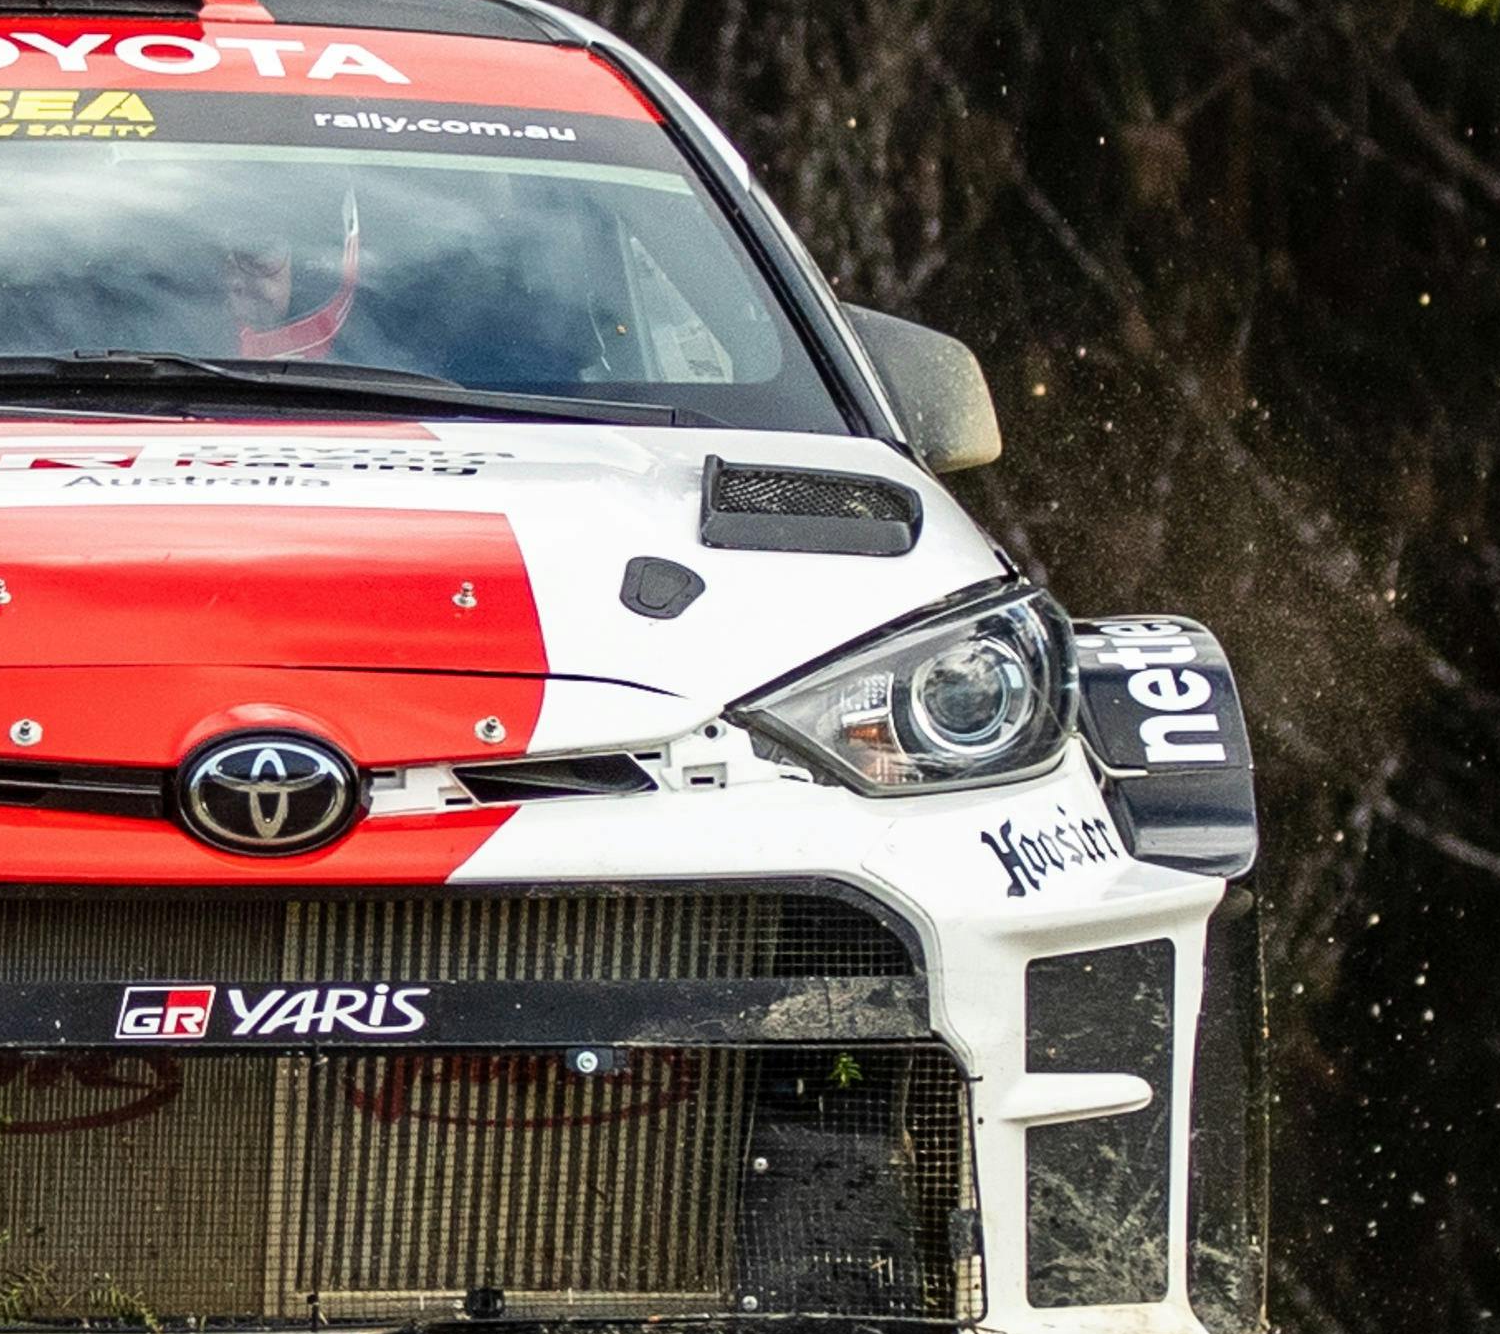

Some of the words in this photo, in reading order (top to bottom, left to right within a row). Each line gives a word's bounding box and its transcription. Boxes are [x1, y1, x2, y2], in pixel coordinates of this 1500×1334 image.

[26, 124, 157, 138] SAFETY
[313, 112, 577, 142] rally.com.au
[61, 474, 332, 488] Australia
[1075, 620, 1227, 762] netie
[980, 803, 1120, 898] Hoosier
[122, 1006, 206, 1035] GR
